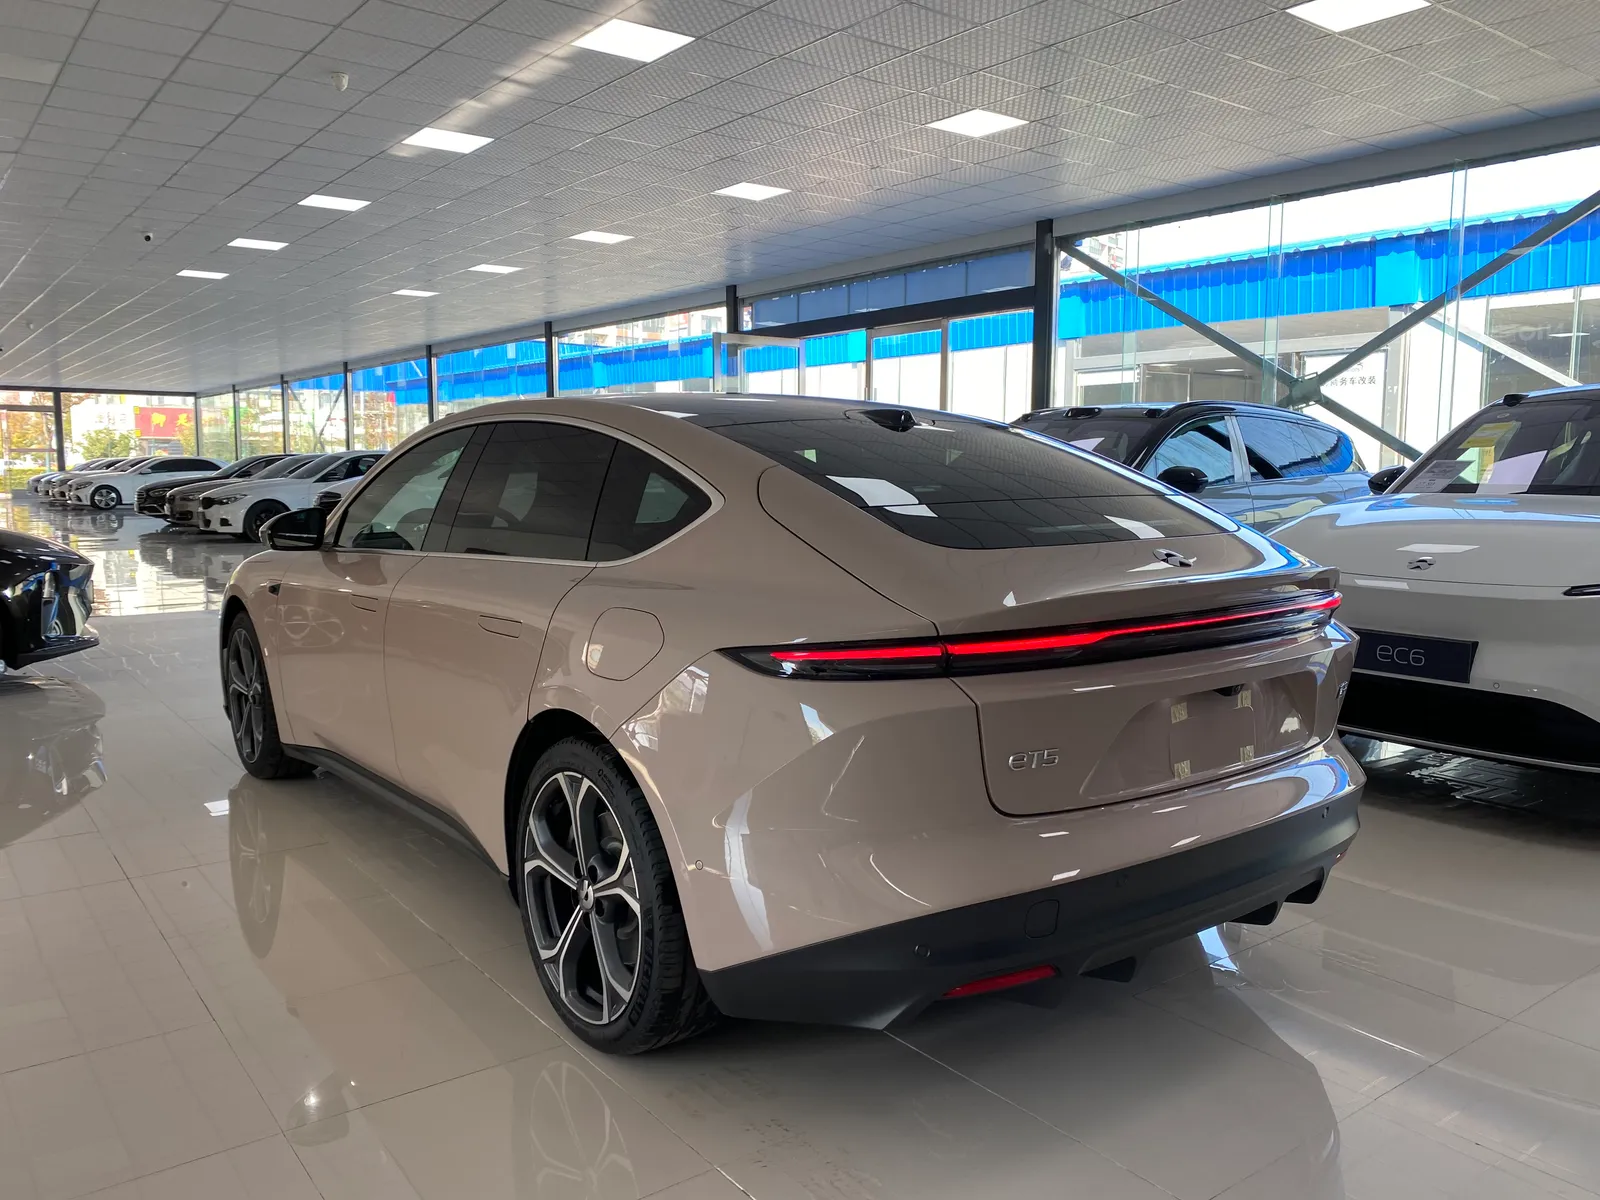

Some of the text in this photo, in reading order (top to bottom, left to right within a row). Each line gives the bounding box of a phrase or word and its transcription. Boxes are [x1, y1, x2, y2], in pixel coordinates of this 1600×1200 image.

[1326, 375, 1377, 387] 商务车改装
